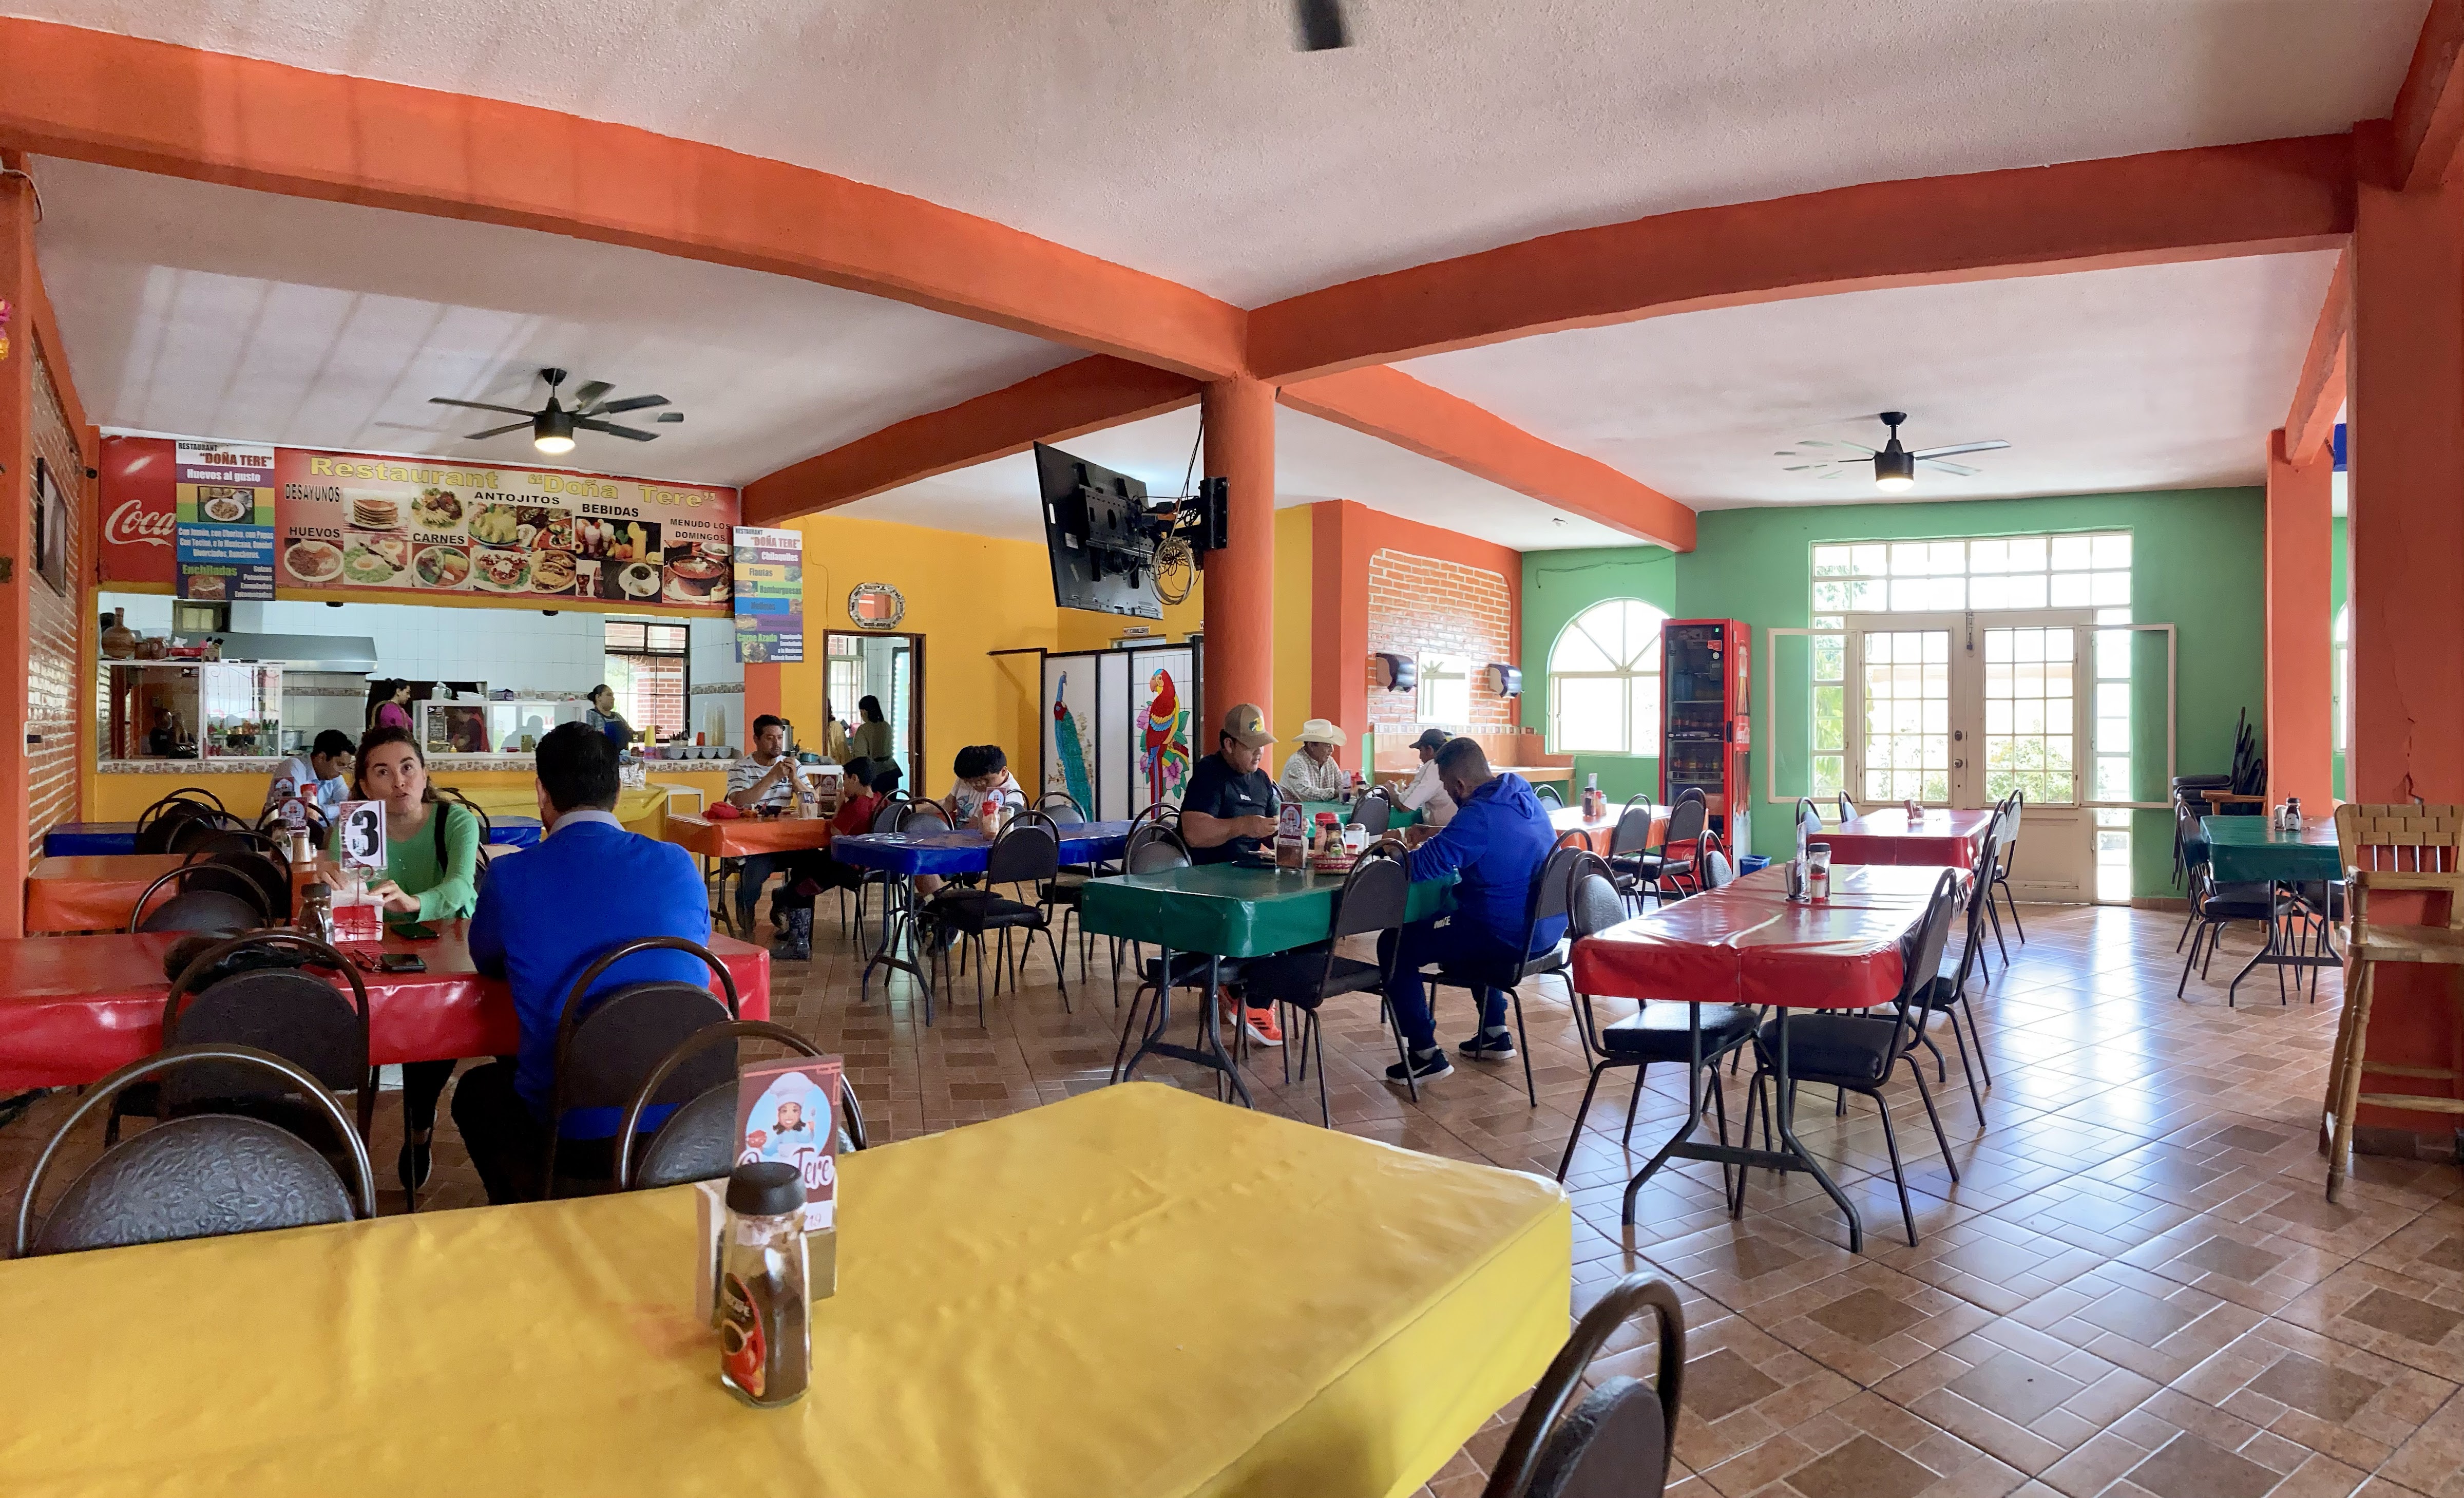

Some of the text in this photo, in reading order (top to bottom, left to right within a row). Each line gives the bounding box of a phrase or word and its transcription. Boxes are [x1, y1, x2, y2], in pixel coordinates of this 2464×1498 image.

[178, 443, 218, 451] RESTAURANT
[187, 468, 261, 482] Huevos al gusto
[310, 457, 498, 488] Restaurant
[285, 483, 340, 502] DESAYUNOS
[474, 491, 560, 505] ANTOJITOS
[582, 503, 639, 517] BEBIDAS
[670, 518, 731, 530] MENUDO LOS
[290, 526, 340, 538] HUEVOS
[675, 531, 726, 541] DOMINGOS
[413, 533, 465, 544] CARNES
[761, 552, 798, 562] Chilaquiles
[182, 564, 237, 576] Enchiladas
[749, 568, 773, 577] Flautas
[737, 633, 757, 642] Carne
[352, 810, 379, 857] 3
[793, 1147, 829, 1185] Tere
